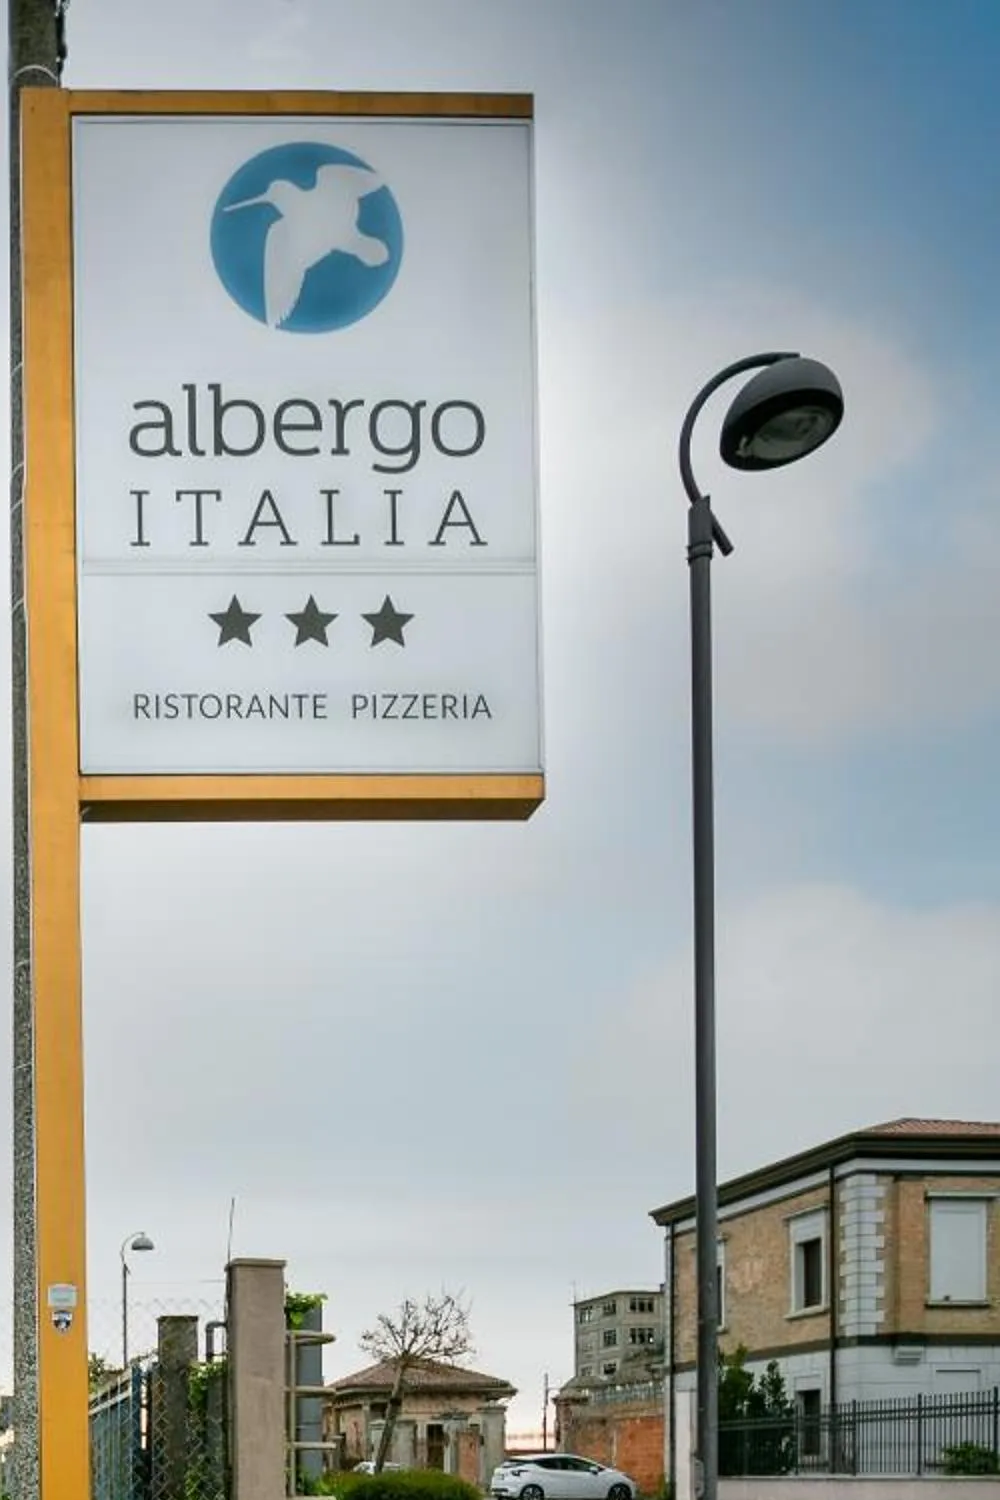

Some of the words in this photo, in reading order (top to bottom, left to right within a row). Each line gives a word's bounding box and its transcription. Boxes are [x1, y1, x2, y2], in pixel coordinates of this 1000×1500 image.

[129, 383, 486, 475] albergo
[129, 489, 488, 547] ITALIA
[134, 693, 328, 720] RISTORANTE
[351, 693, 493, 720] PIZZERIA
